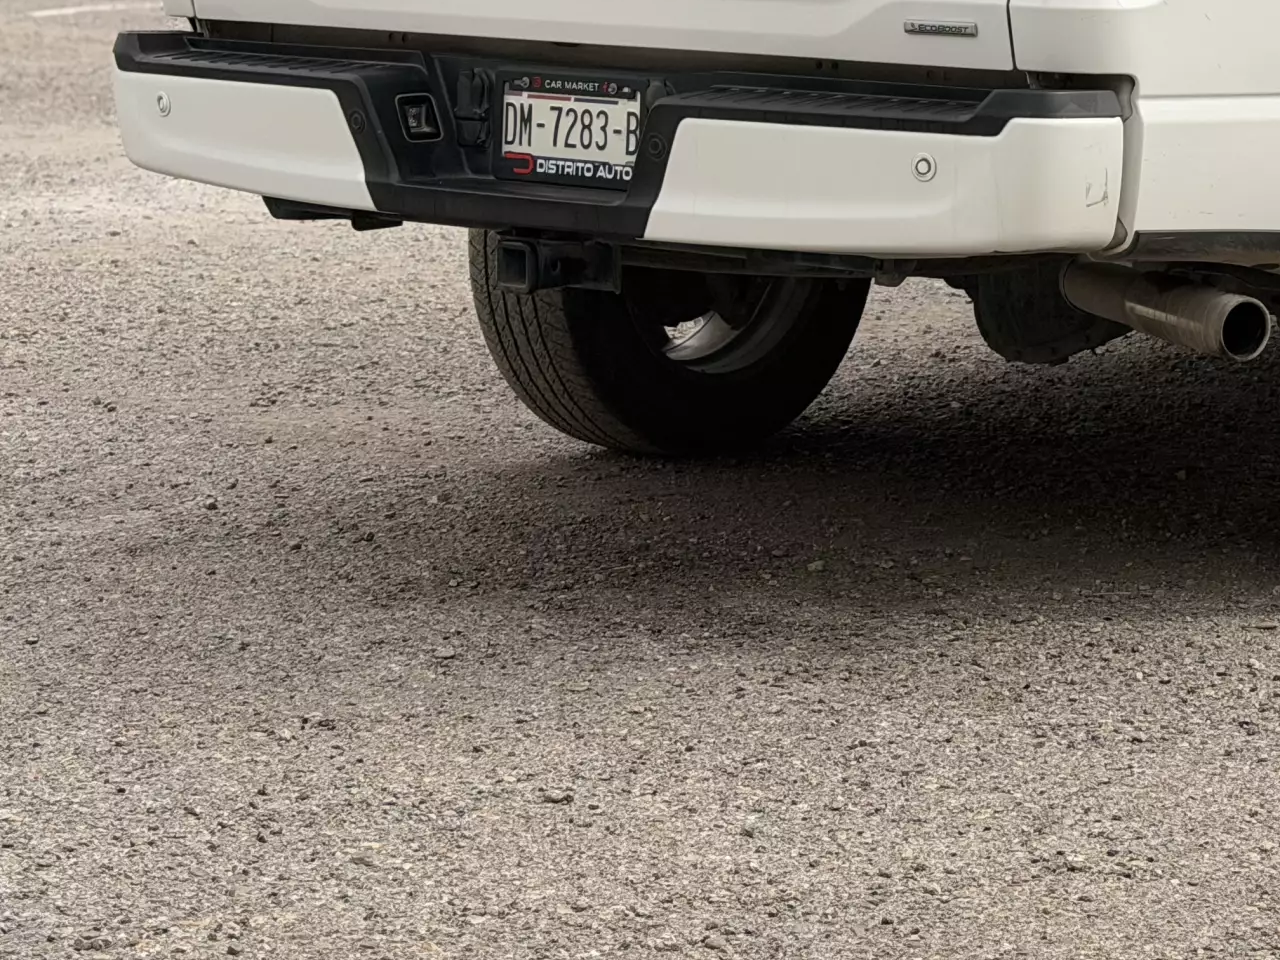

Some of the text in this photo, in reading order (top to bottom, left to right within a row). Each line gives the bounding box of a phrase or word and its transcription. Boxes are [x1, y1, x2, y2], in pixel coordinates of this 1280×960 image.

[544, 79, 600, 91] CAR MARKET
[504, 102, 640, 156] DM-7283-B
[536, 159, 633, 181] DISTRITO AUTO
